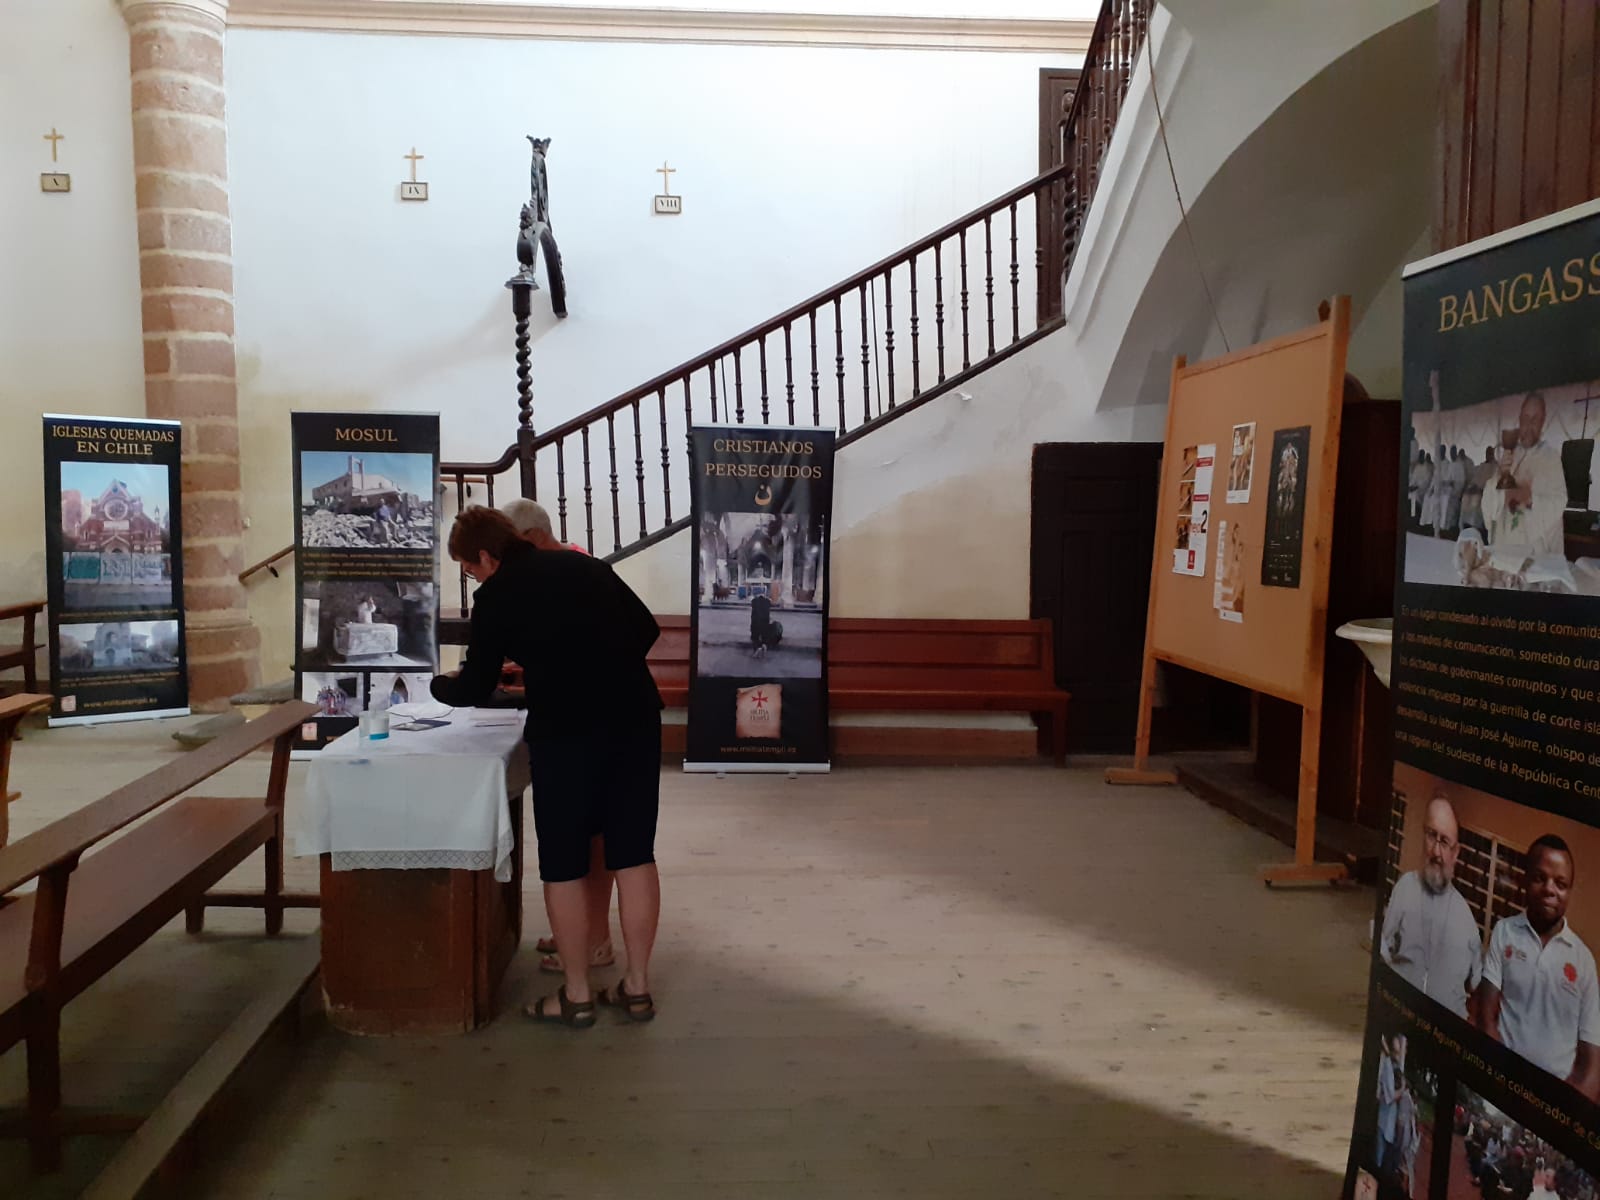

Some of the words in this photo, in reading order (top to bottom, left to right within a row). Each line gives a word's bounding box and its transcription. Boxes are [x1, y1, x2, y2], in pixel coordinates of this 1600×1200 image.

[409, 186, 419, 194] IX
[660, 200, 676, 208] VIII
[52, 425, 107, 439] IGLESIAS
[110, 428, 175, 442] QUEMADAS
[335, 427, 398, 442] MOSUL
[77, 441, 99, 453] EN
[105, 442, 153, 455] CHILE
[713, 439, 814, 455] CRISTIANOS
[705, 463, 822, 479] PERSEGUIDOS
[754, 484, 772, 506] ن
[1518, 620, 1536, 634] por
[1537, 619, 1547, 633] la
[1519, 648, 1570, 667] sometido
[1450, 665, 1504, 686] gobernantes
[1506, 676, 1558, 696] corruptos
[1560, 686, 1568, 700] y
[1570, 686, 1594, 703] que
[1463, 696, 1478, 710] por
[1479, 697, 1488, 710] la
[1490, 701, 1530, 721] guerrilla
[1532, 709, 1547, 723] de
[1550, 714, 1582, 731] corte
[1439, 714, 1458, 731] labor
[1459, 721, 1479, 736] Juan
[1480, 725, 1499, 742] José
[1502, 730, 1542, 755] Aguirre,
[1546, 743, 1585, 763] obispo
[1432, 741, 1445, 753] del
[1446, 745, 1482, 765] sudeste
[1484, 756, 1497, 770] de
[1499, 759, 1508, 774] la
[1511, 763, 1570, 790] República
[1462, 1048, 1485, 1072] junto
[1486, 1064, 1493, 1076] a
[1493, 1070, 1506, 1087] un
[1508, 1079, 1572, 1126] colaborador
